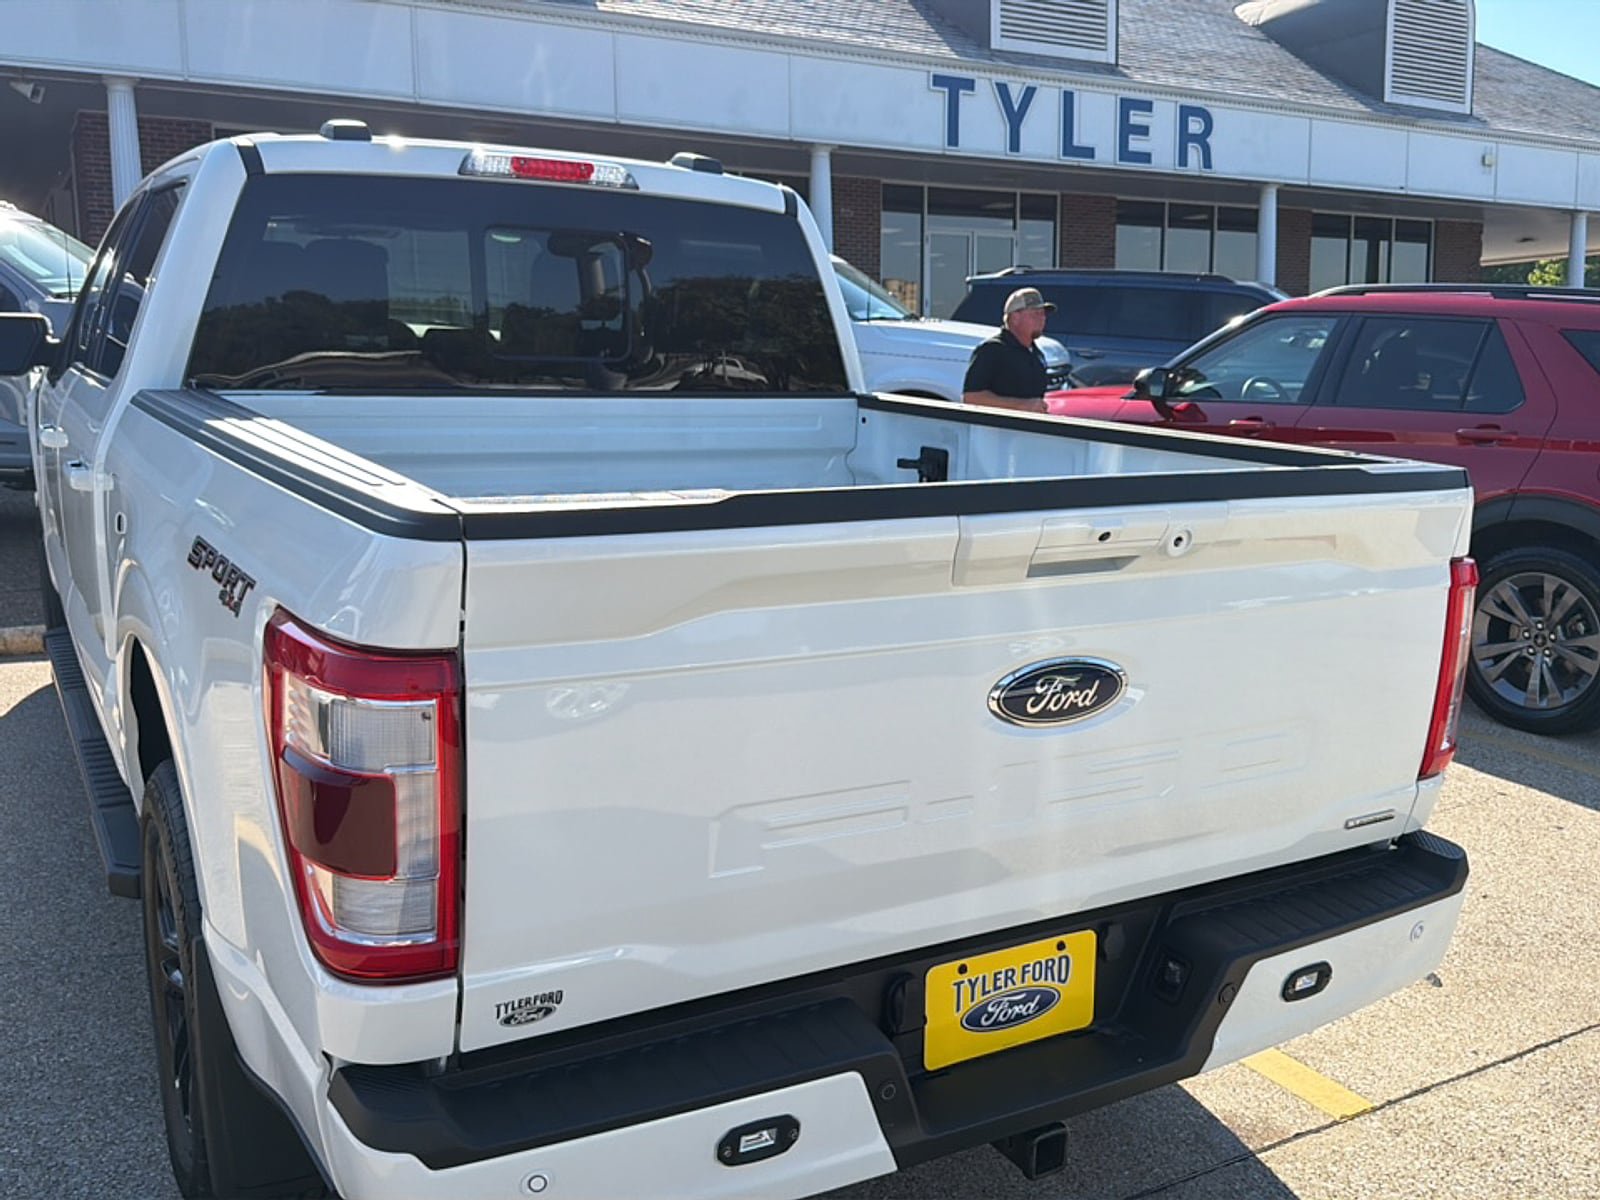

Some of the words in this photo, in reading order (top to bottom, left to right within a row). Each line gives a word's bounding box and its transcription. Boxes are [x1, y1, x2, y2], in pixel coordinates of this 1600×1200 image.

[931, 73, 1213, 169] TYLER
[187, 535, 256, 602] SPORT
[1026, 673, 1100, 714] Ford
[953, 967, 1017, 1013] TYLER
[1021, 955, 1070, 985] FORD
[980, 992, 1041, 1027] Ford
